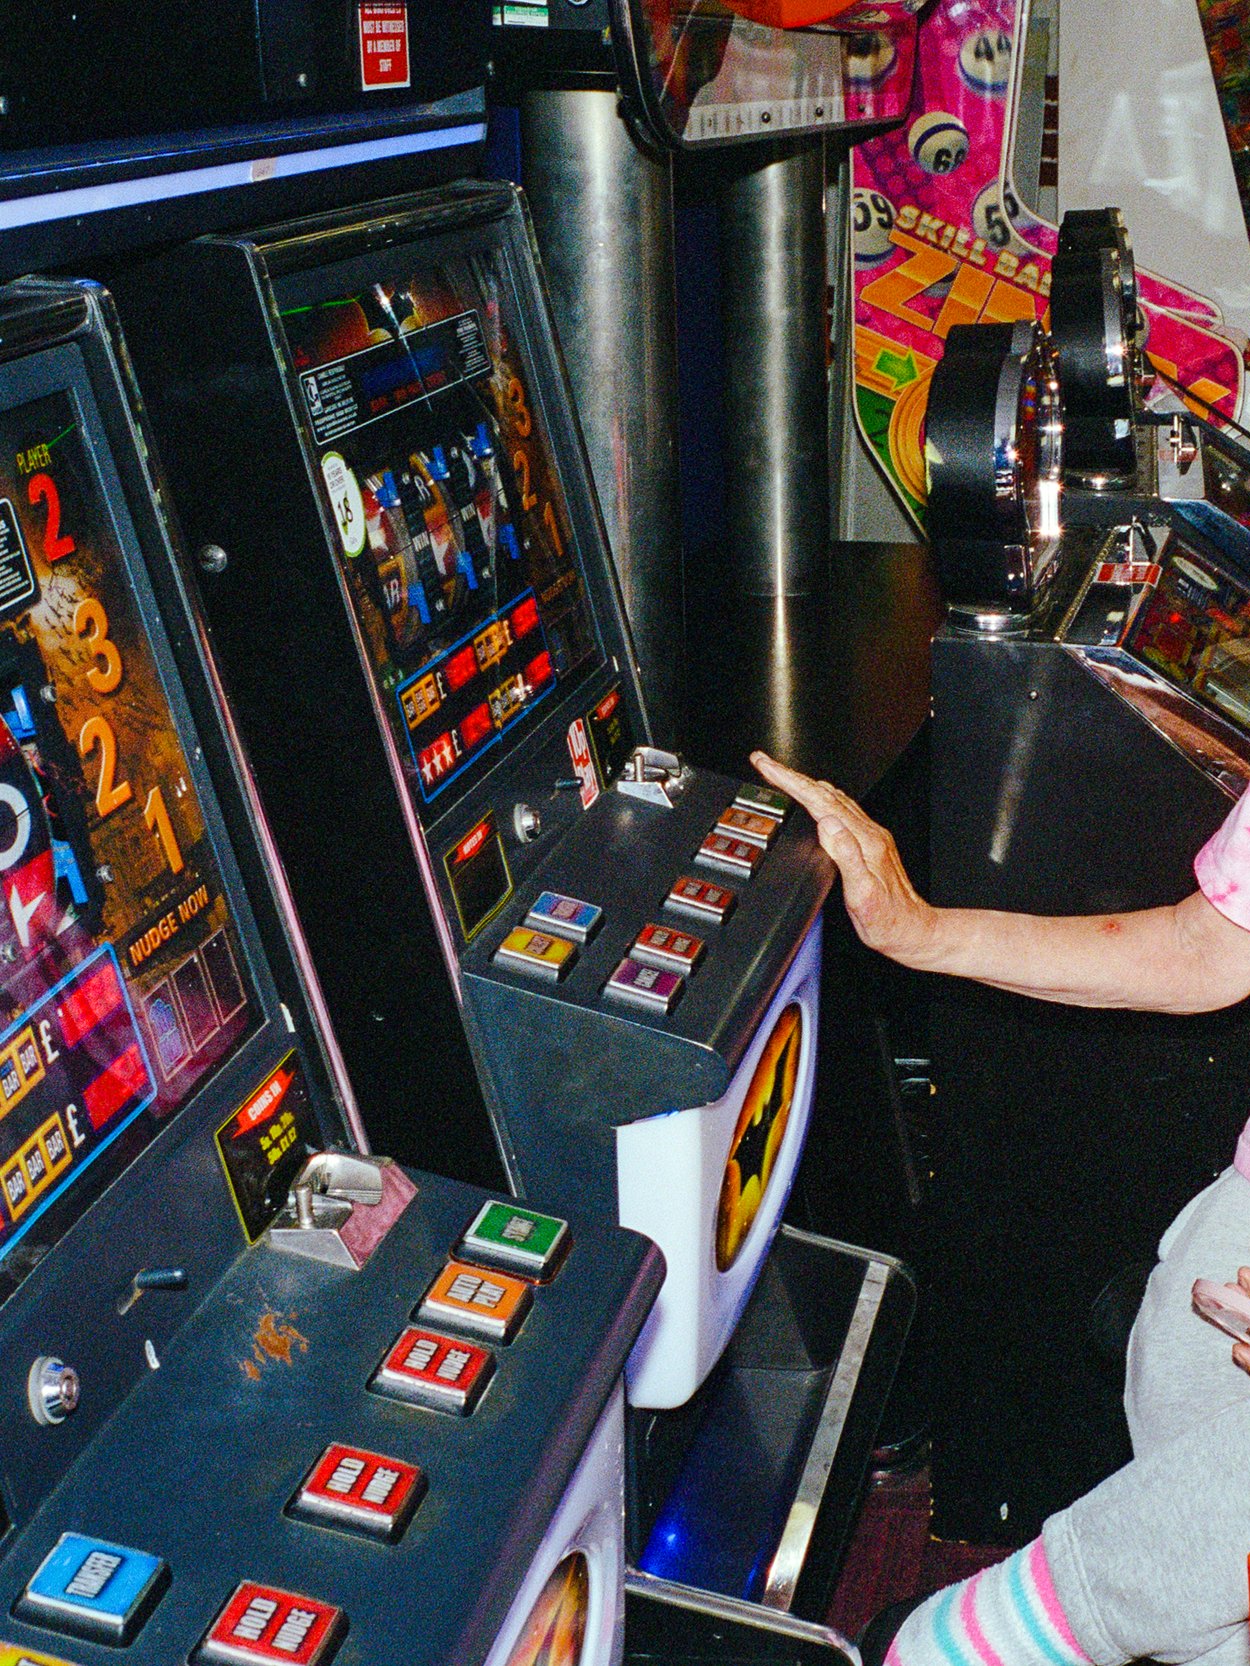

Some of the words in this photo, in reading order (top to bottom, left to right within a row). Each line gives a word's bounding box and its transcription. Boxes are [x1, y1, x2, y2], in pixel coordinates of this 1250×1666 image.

[895, 204, 988, 266] SKILL
[17, 443, 51, 475] PLAYER
[514, 449, 537, 511] 2
[28, 472, 76, 562] 2
[74, 598, 123, 694] 3
[79, 715, 133, 817] 2
[144, 785, 184, 874] 1
[129, 911, 179, 967] NUDGE
[178, 884, 209, 924] NOW
[2, 1070, 21, 1100] BAR
[20, 1044, 39, 1076] BAR
[39, 1019, 60, 1065] £
[247, 1089, 275, 1122] COINS
[269, 1080, 283, 1098] IN
[6, 1170, 26, 1203] BAR
[26, 1150, 46, 1181] BAR
[46, 1130, 65, 1161] BAR
[66, 1103, 86, 1149] £
[445, 1273, 484, 1304] AUTO
[471, 1280, 507, 1309] PLAY
[403, 1339, 439, 1371] HOLD
[436, 1348, 471, 1382] NUDGE
[325, 1457, 366, 1494] HOLD
[361, 1466, 400, 1505] NUDGE
[65, 1551, 123, 1599] TRANSFER
[232, 1597, 278, 1641] HOLD
[271, 1607, 317, 1653] NUDGE
